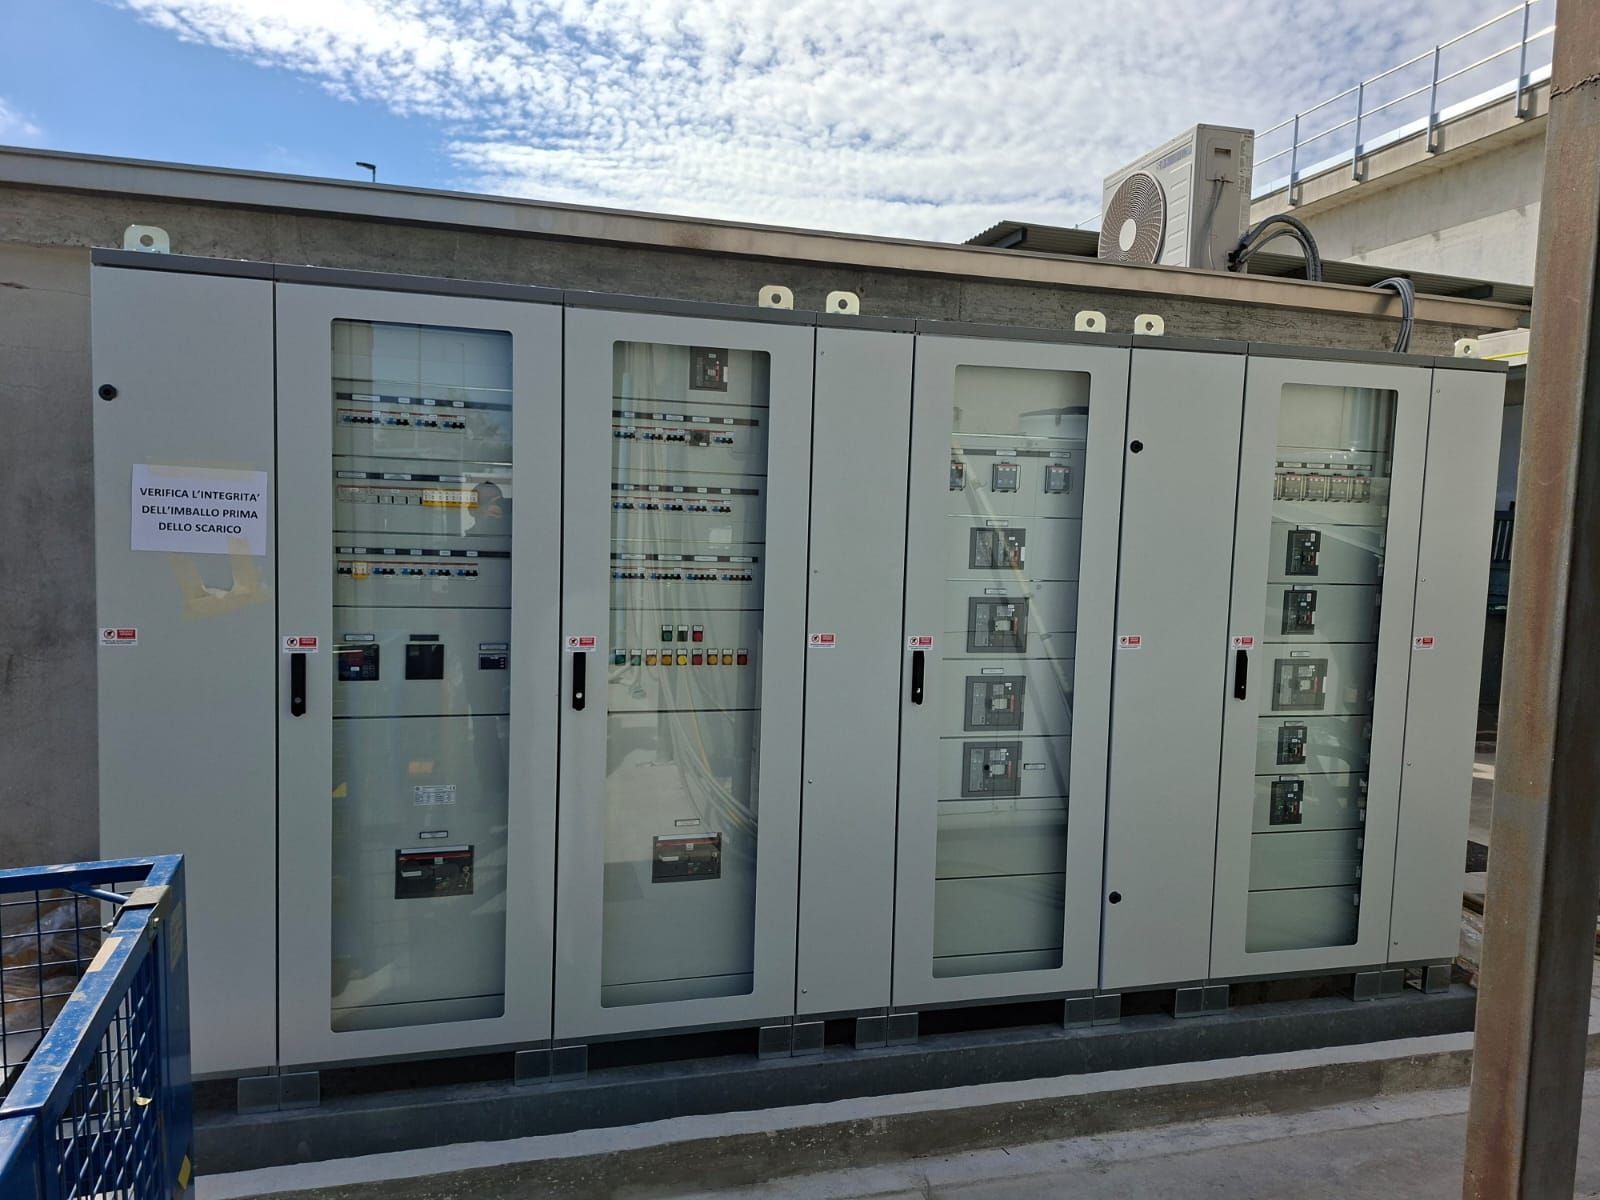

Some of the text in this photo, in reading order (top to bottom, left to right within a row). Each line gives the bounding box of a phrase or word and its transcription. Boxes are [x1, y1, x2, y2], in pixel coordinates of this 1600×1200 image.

[140, 487, 260, 502] VERIFICA L'INTEGRITA'
[142, 505, 258, 519] DELL'IMBALLO PRIMA
[159, 522, 242, 534] DELLO SCARICO
